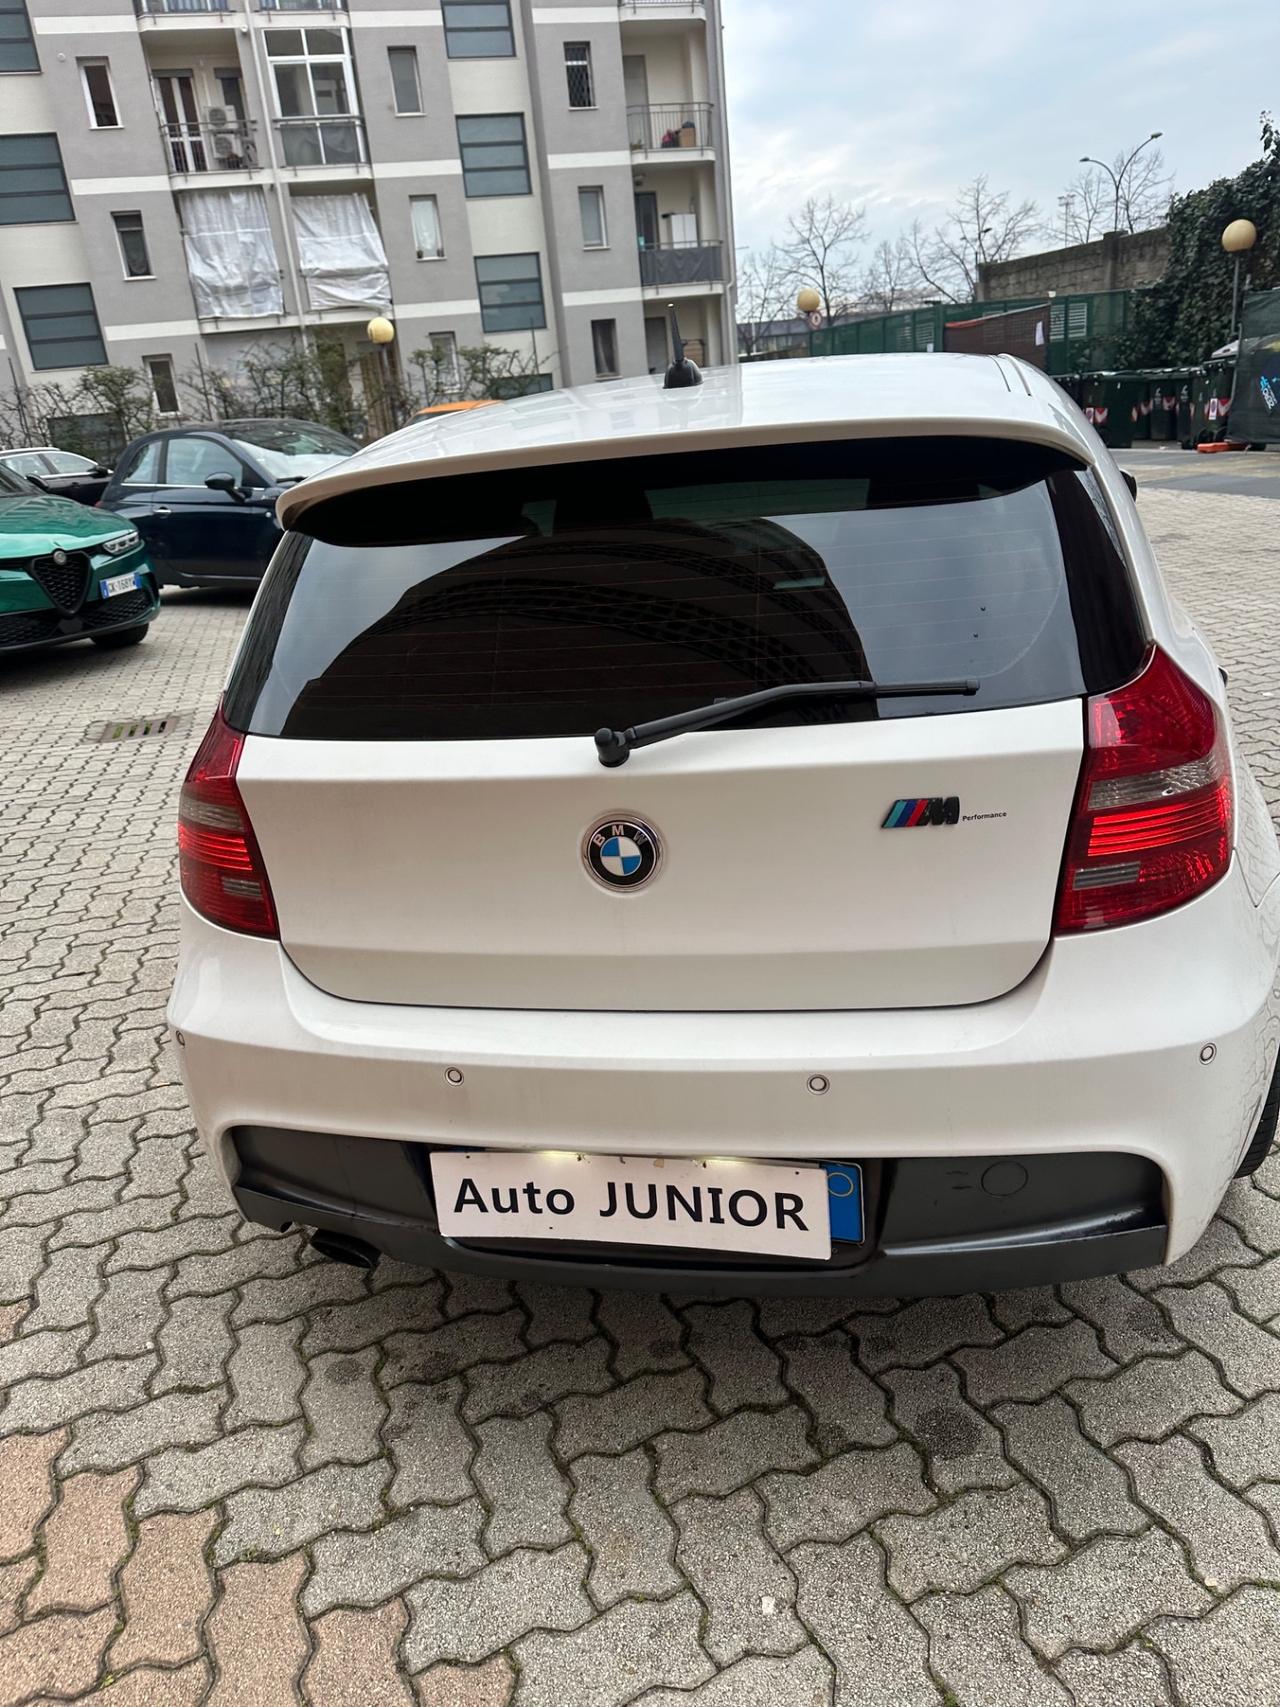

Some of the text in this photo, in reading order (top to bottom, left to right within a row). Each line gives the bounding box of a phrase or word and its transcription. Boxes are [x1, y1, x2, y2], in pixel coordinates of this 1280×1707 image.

[962, 811, 1008, 822] Performance
[592, 824, 648, 848] BMW
[453, 1177, 810, 1232] Auto JUNIOR
